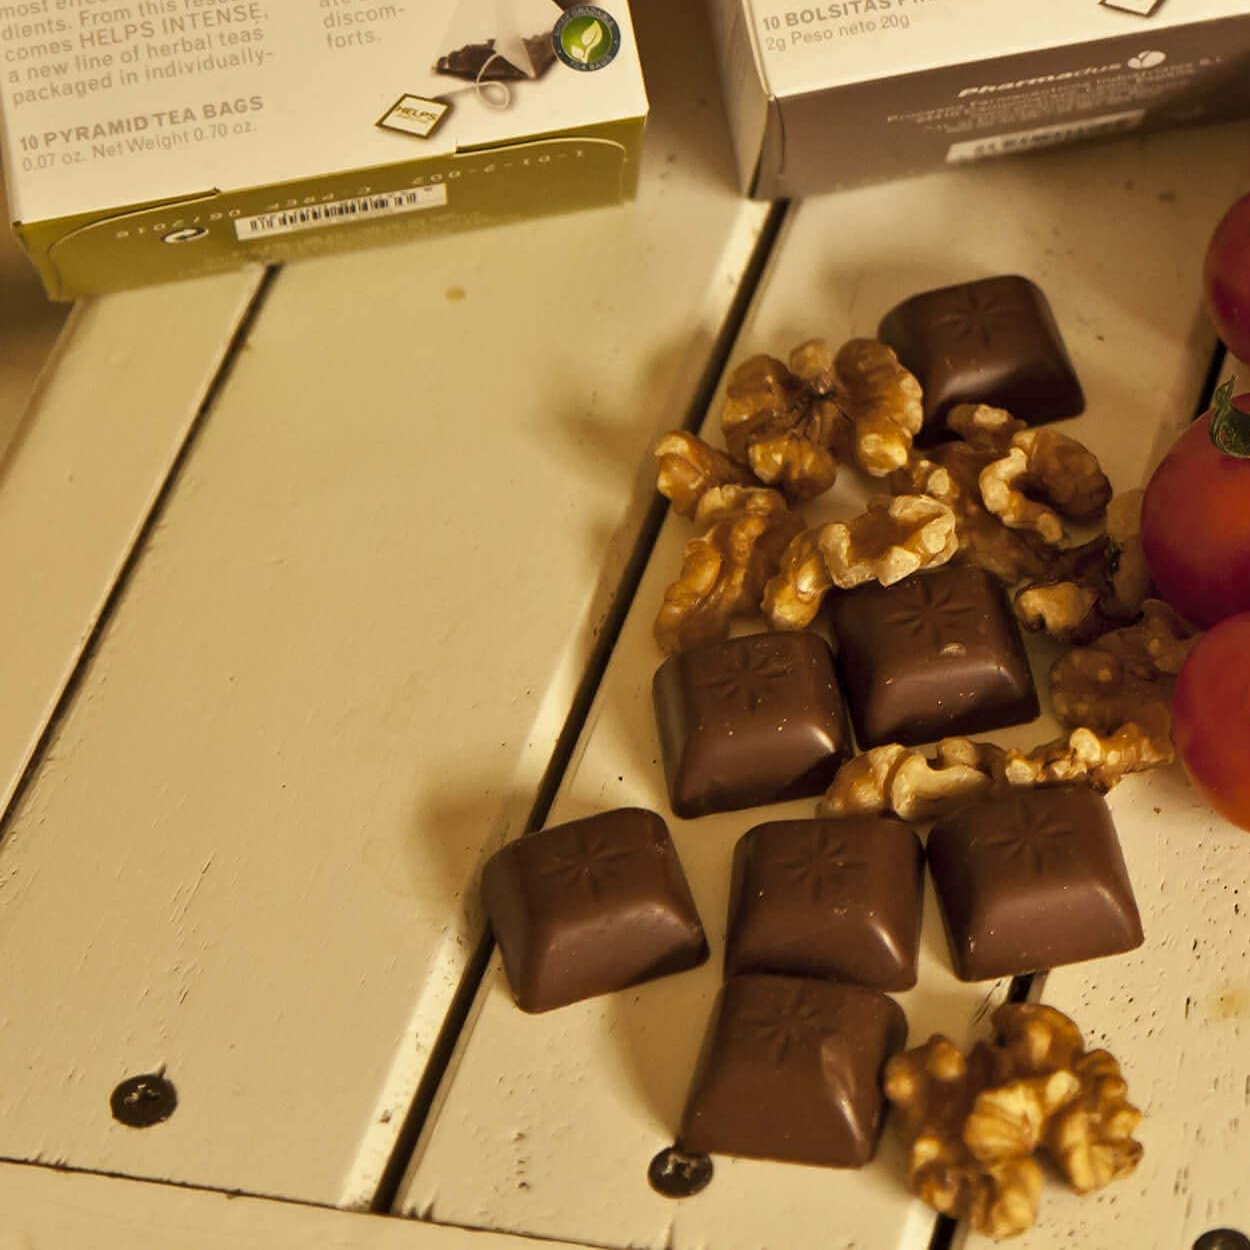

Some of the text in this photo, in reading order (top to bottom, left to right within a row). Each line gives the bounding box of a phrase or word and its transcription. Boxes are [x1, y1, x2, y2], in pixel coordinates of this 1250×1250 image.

[1, 0, 49, 21] most
[2, 18, 72, 42] dients.
[79, 7, 132, 29] From
[323, 5, 406, 30] discom-
[763, 16, 780, 32] 10
[5, 2, 269, 63] comes HELPS INTENSE,
[327, 28, 381, 50] forts.
[765, 12, 911, 52] 2g Peso neto 20g
[27, 25, 264, 82] new line of herbal teas
[12, 46, 274, 107] packaged in individually-
[20, 95, 264, 151] 10 PYRAMID TEA BAGS
[22, 119, 257, 172] 0.07 oz. Net Weight 0.70 oz.
